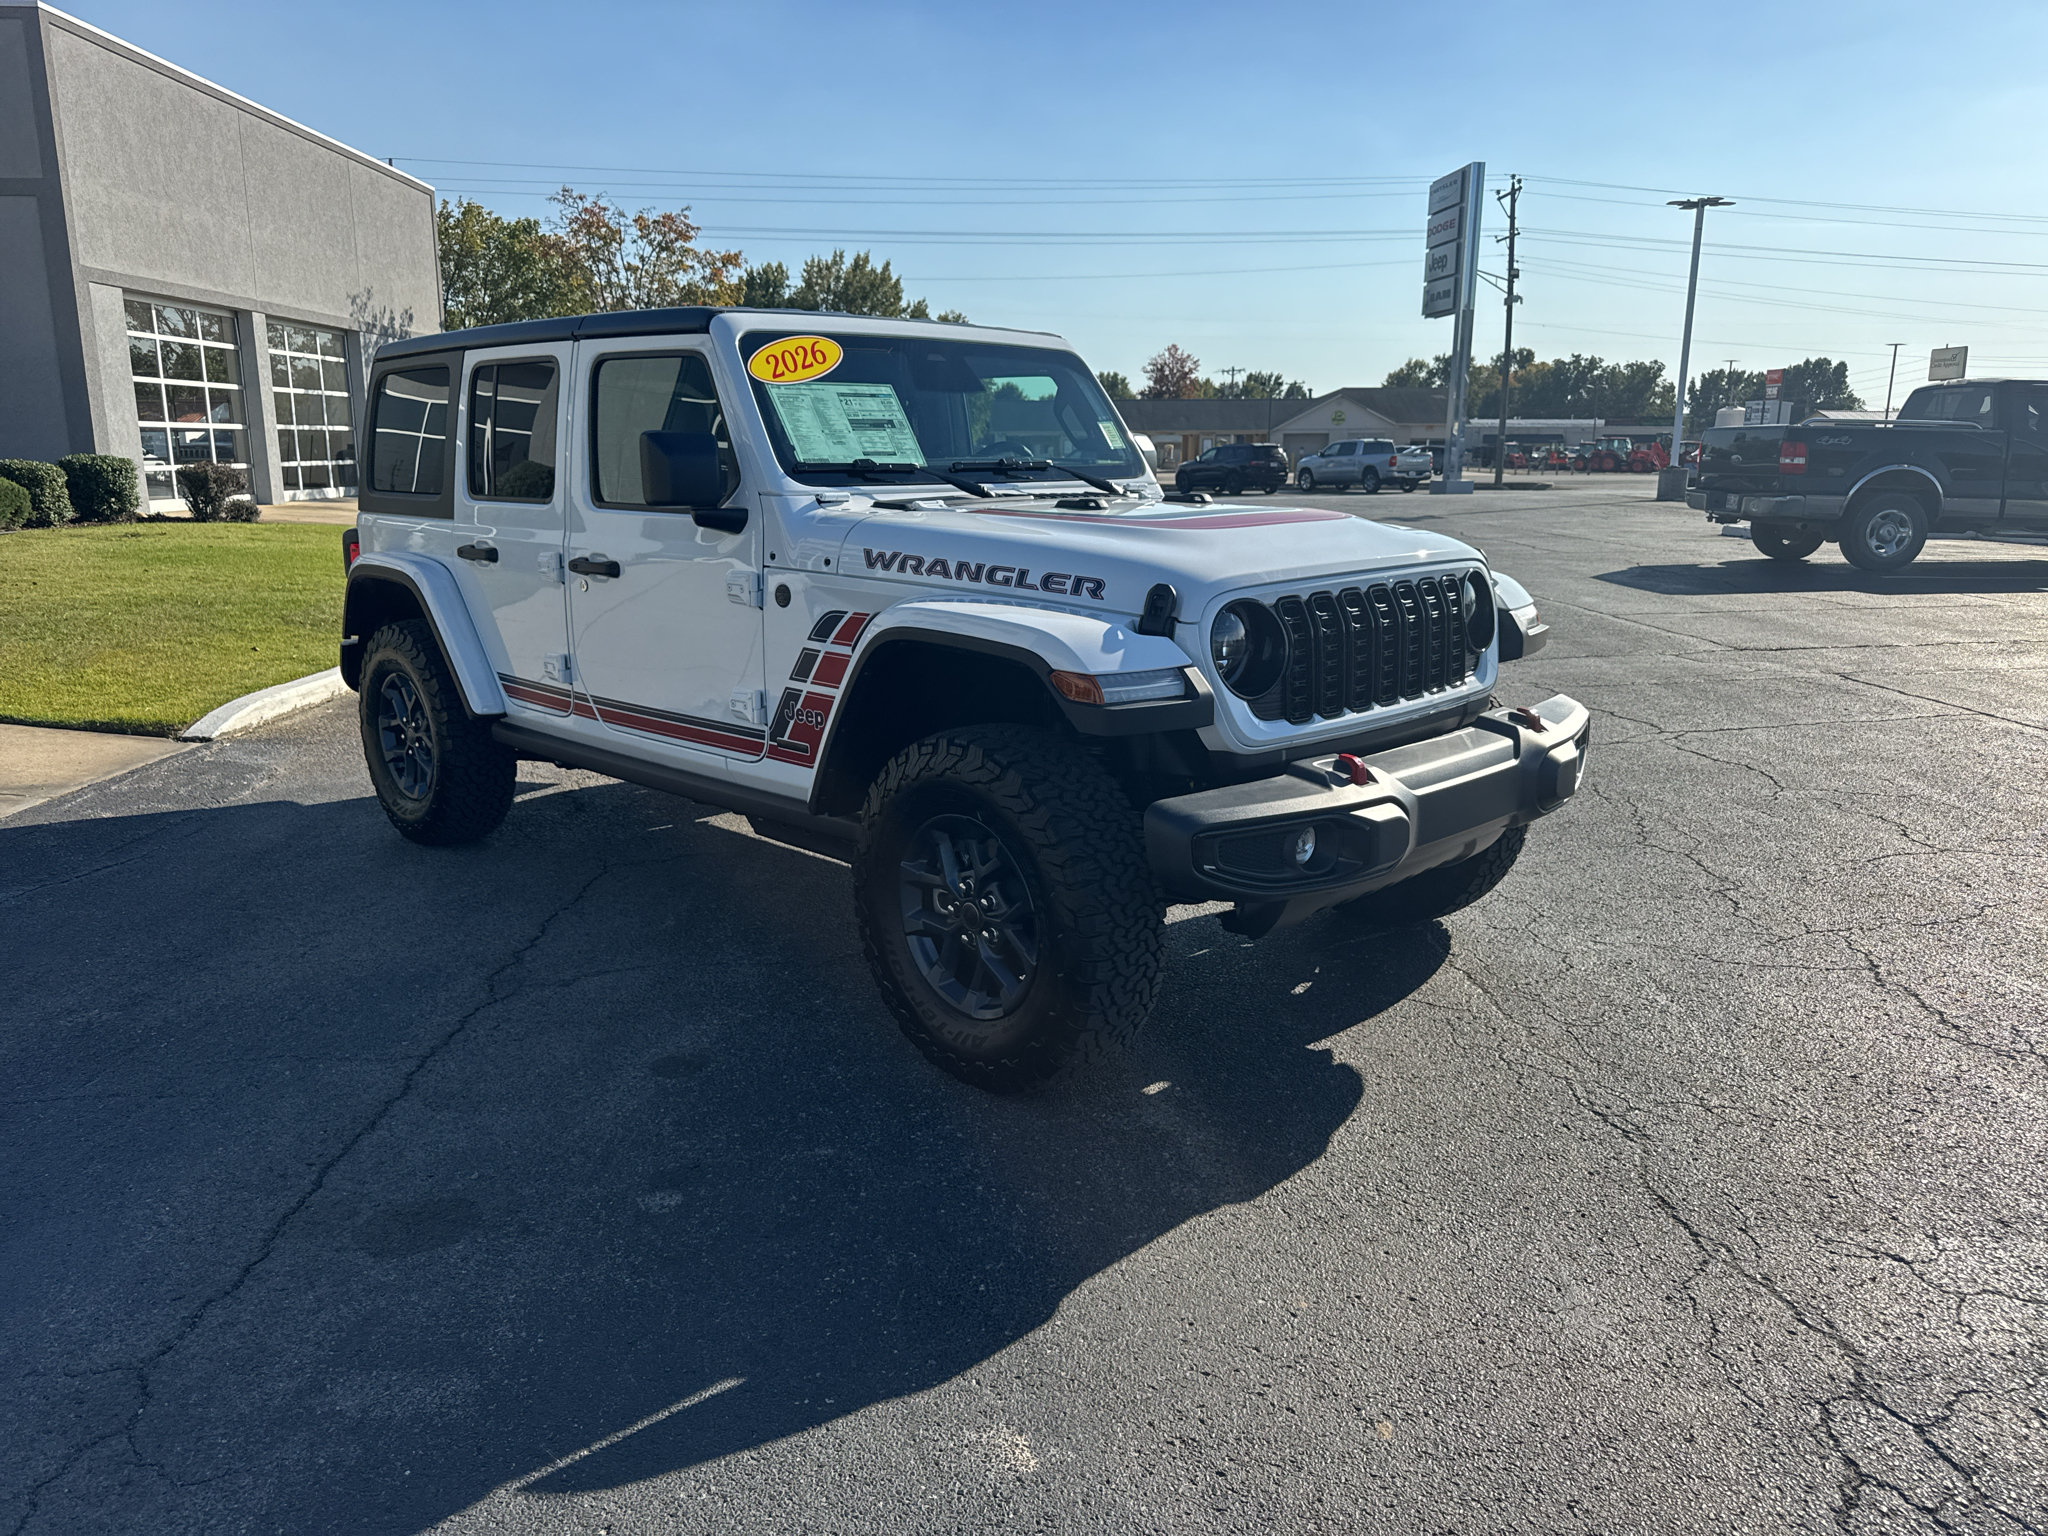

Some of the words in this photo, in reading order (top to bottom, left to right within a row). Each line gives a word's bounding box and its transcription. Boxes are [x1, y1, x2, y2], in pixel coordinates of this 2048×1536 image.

[1428, 218, 1457, 238] DODGE
[1429, 253, 1448, 273] Jeep
[765, 340, 827, 380] 2026
[862, 547, 1106, 601] WRANGLER
[784, 701, 825, 730] Jeep
